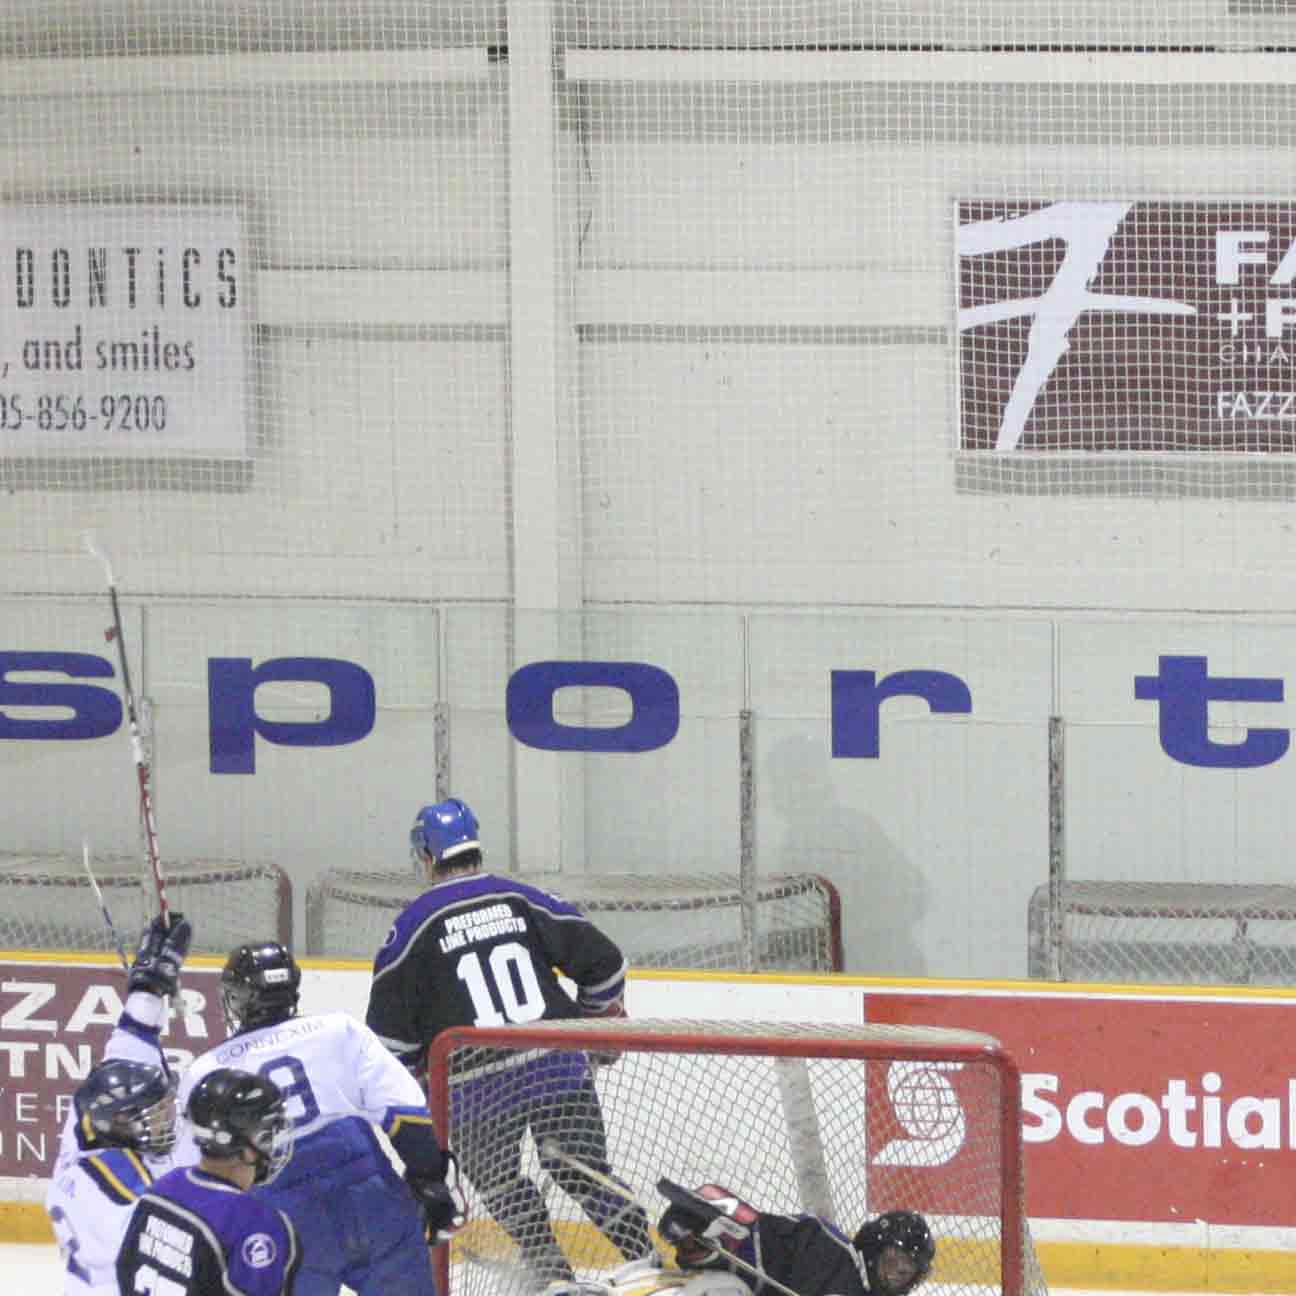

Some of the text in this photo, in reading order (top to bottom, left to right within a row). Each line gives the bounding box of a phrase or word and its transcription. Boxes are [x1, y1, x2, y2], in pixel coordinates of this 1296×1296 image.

[23, 324, 83, 370] and
[95, 325, 195, 371] smiles
[456, 941, 546, 1029] 10
